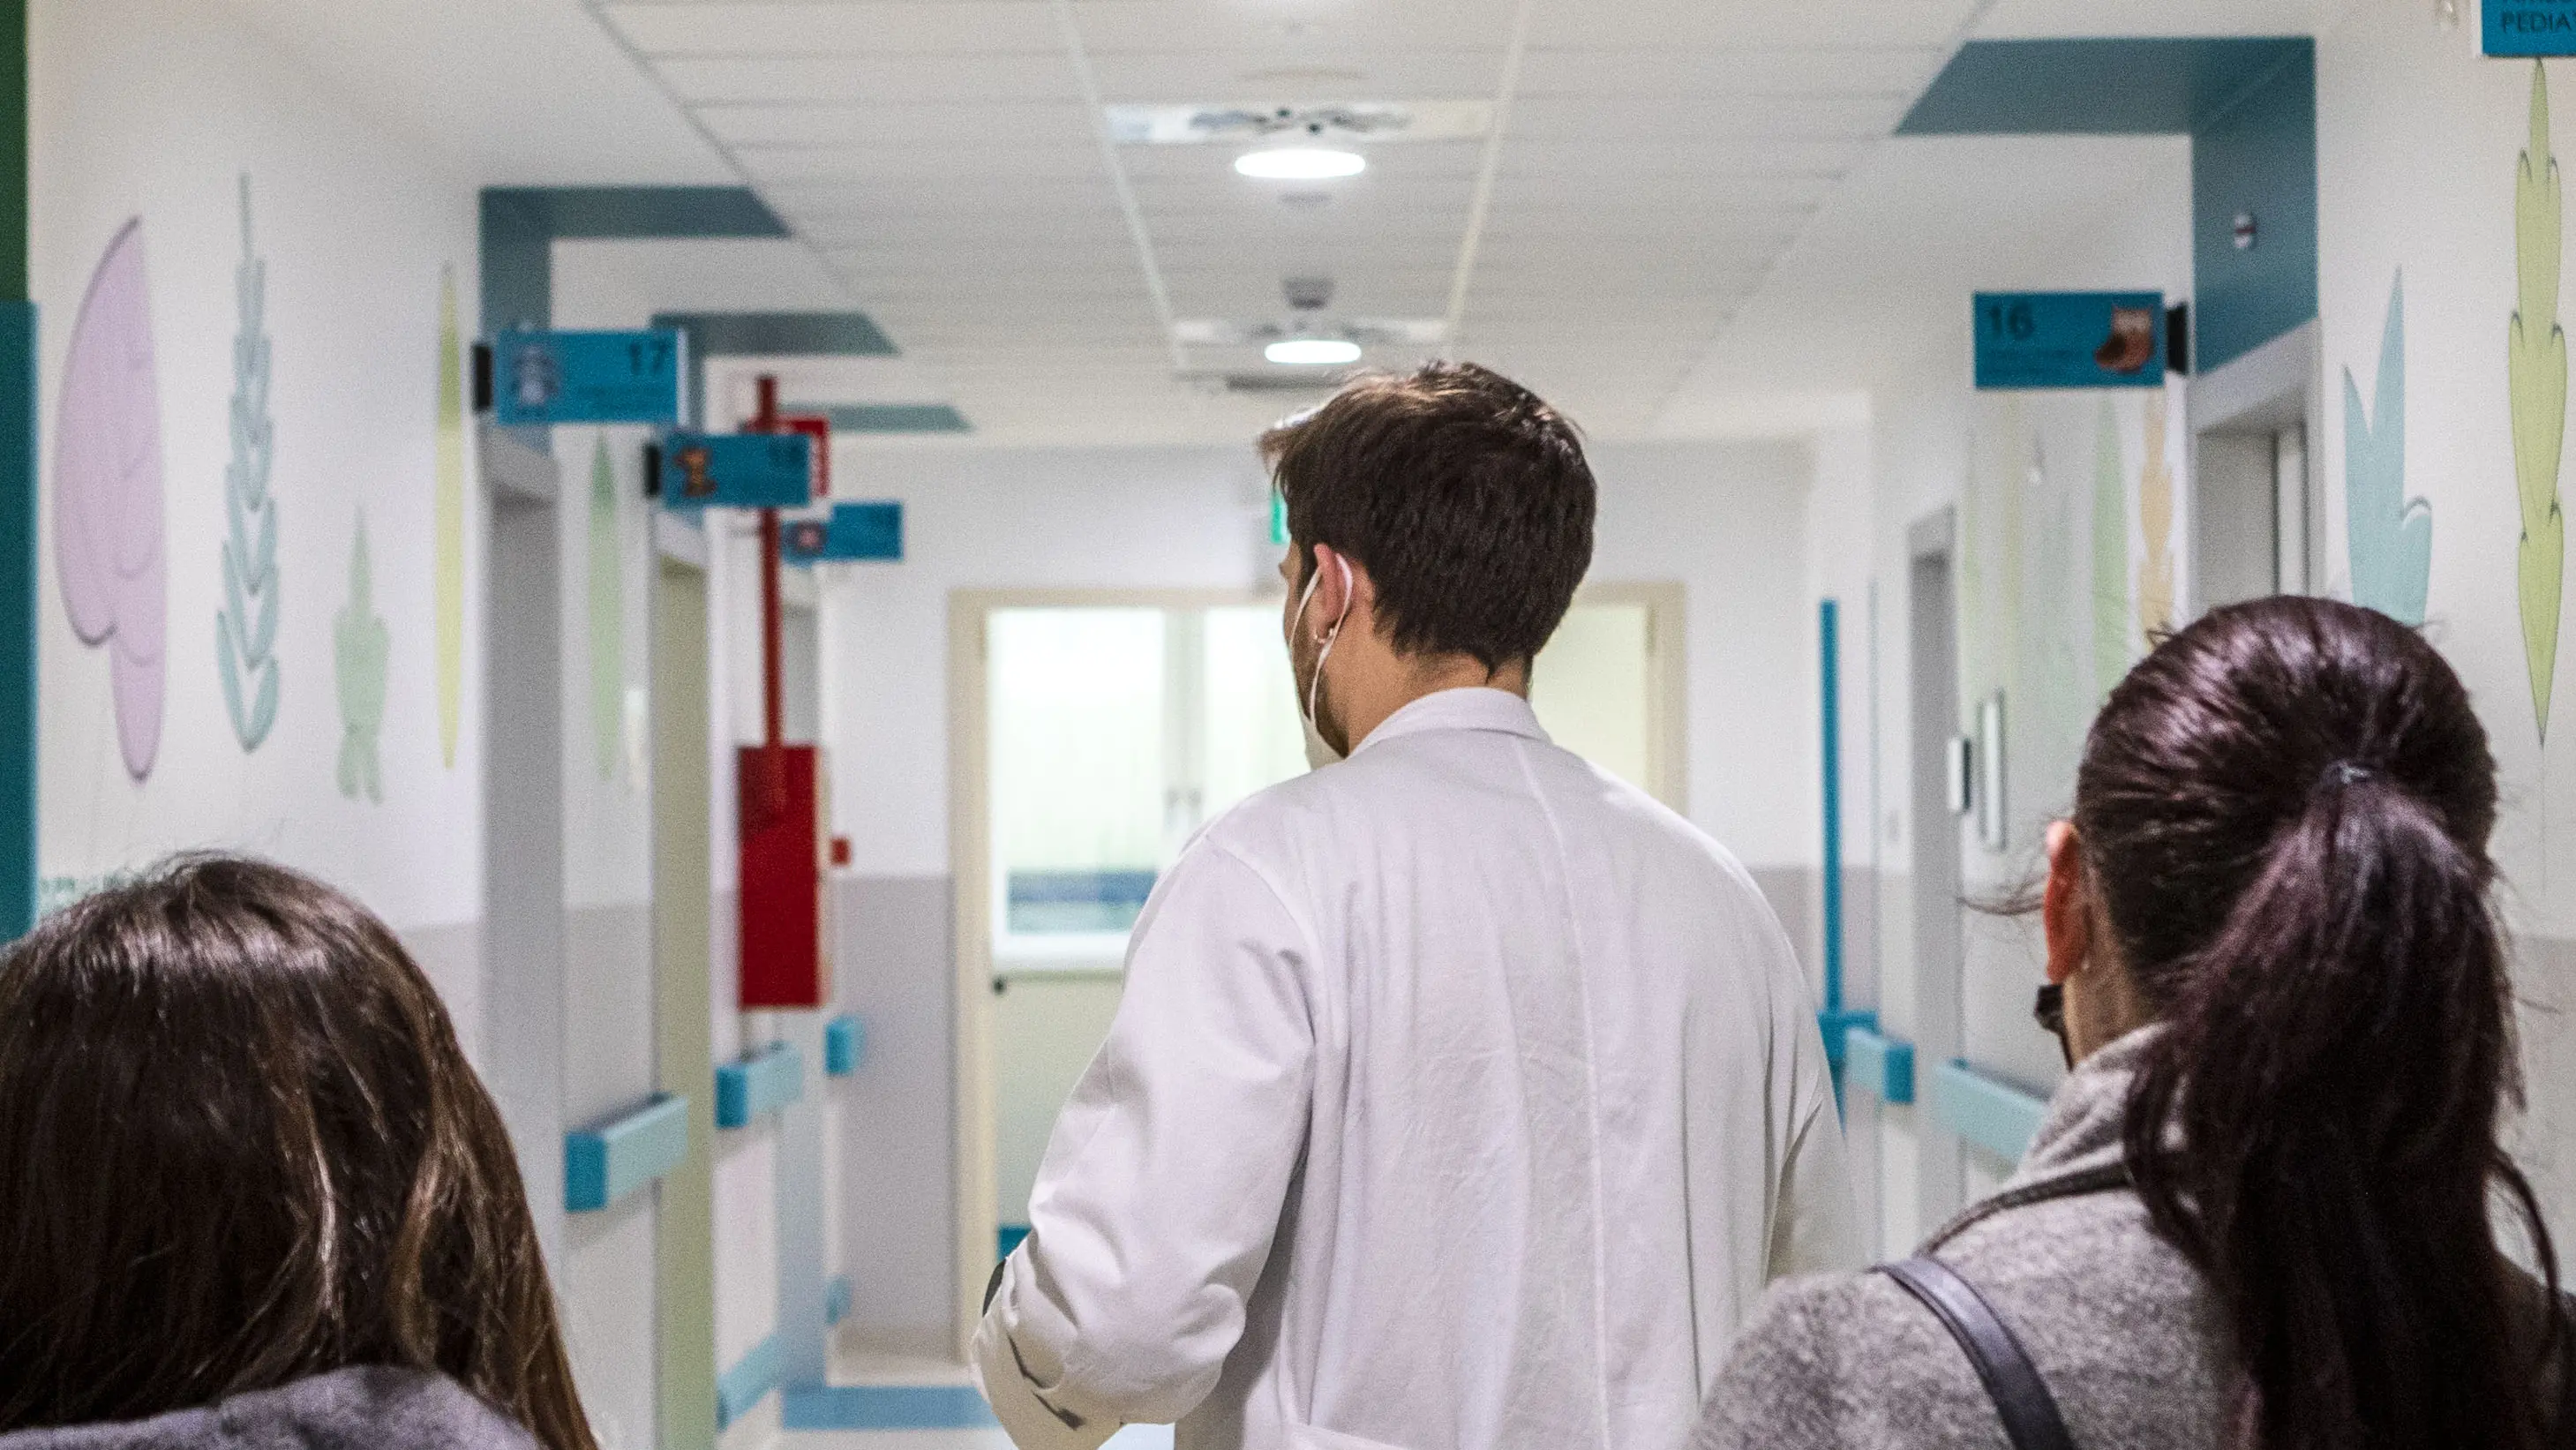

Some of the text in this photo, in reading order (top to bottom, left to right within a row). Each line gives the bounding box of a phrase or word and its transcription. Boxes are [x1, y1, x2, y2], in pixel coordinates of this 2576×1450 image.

[2501, 11, 2576, 34] PEDIA
[1989, 300, 2034, 340] 16
[627, 341, 670, 375] 17
